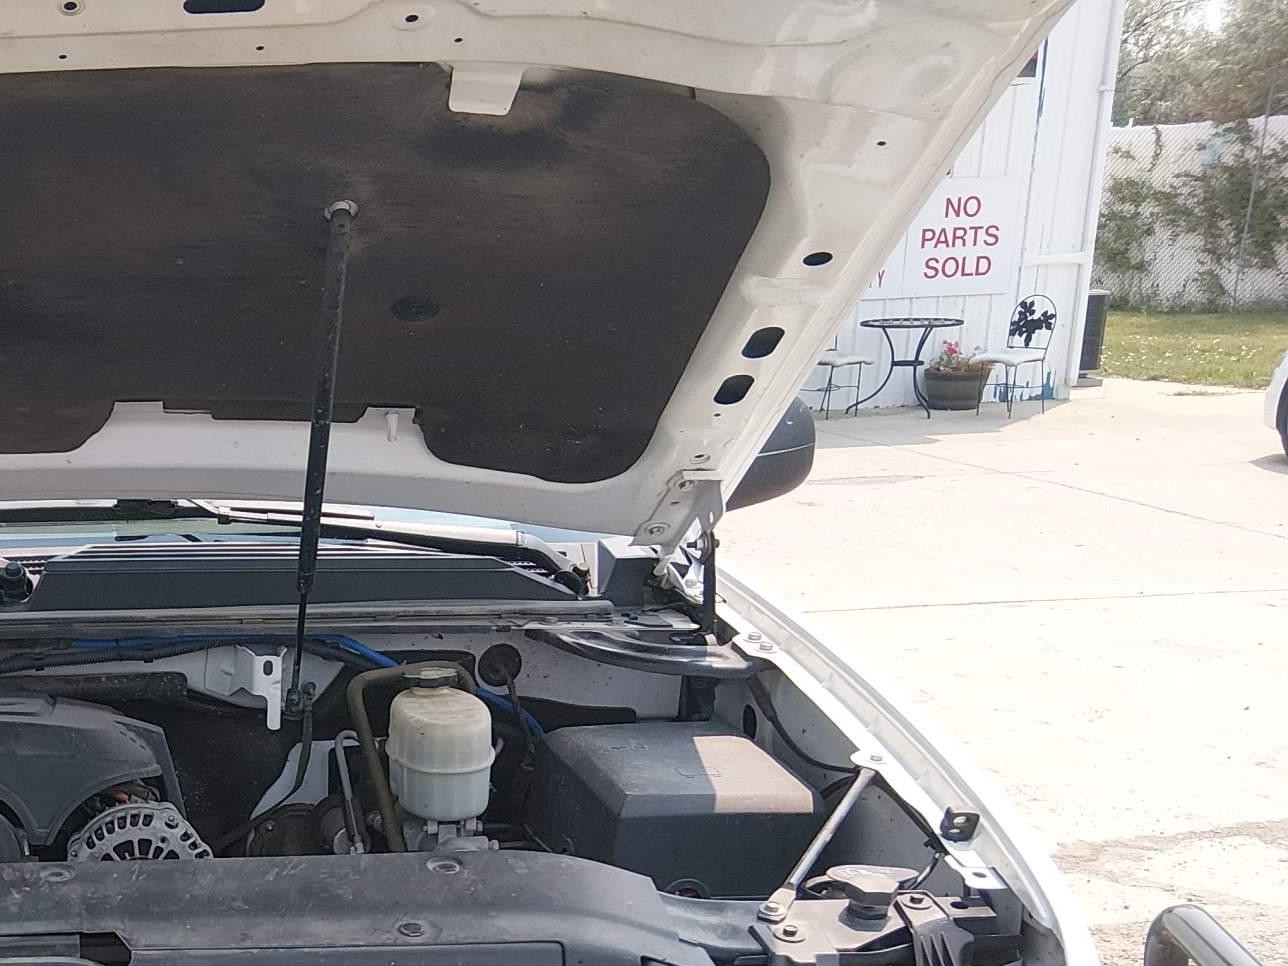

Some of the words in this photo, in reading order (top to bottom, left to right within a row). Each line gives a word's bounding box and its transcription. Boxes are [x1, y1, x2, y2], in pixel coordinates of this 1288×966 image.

[944, 195, 982, 218] NO
[920, 225, 1000, 249] PARTS
[923, 255, 992, 279] SOLD
